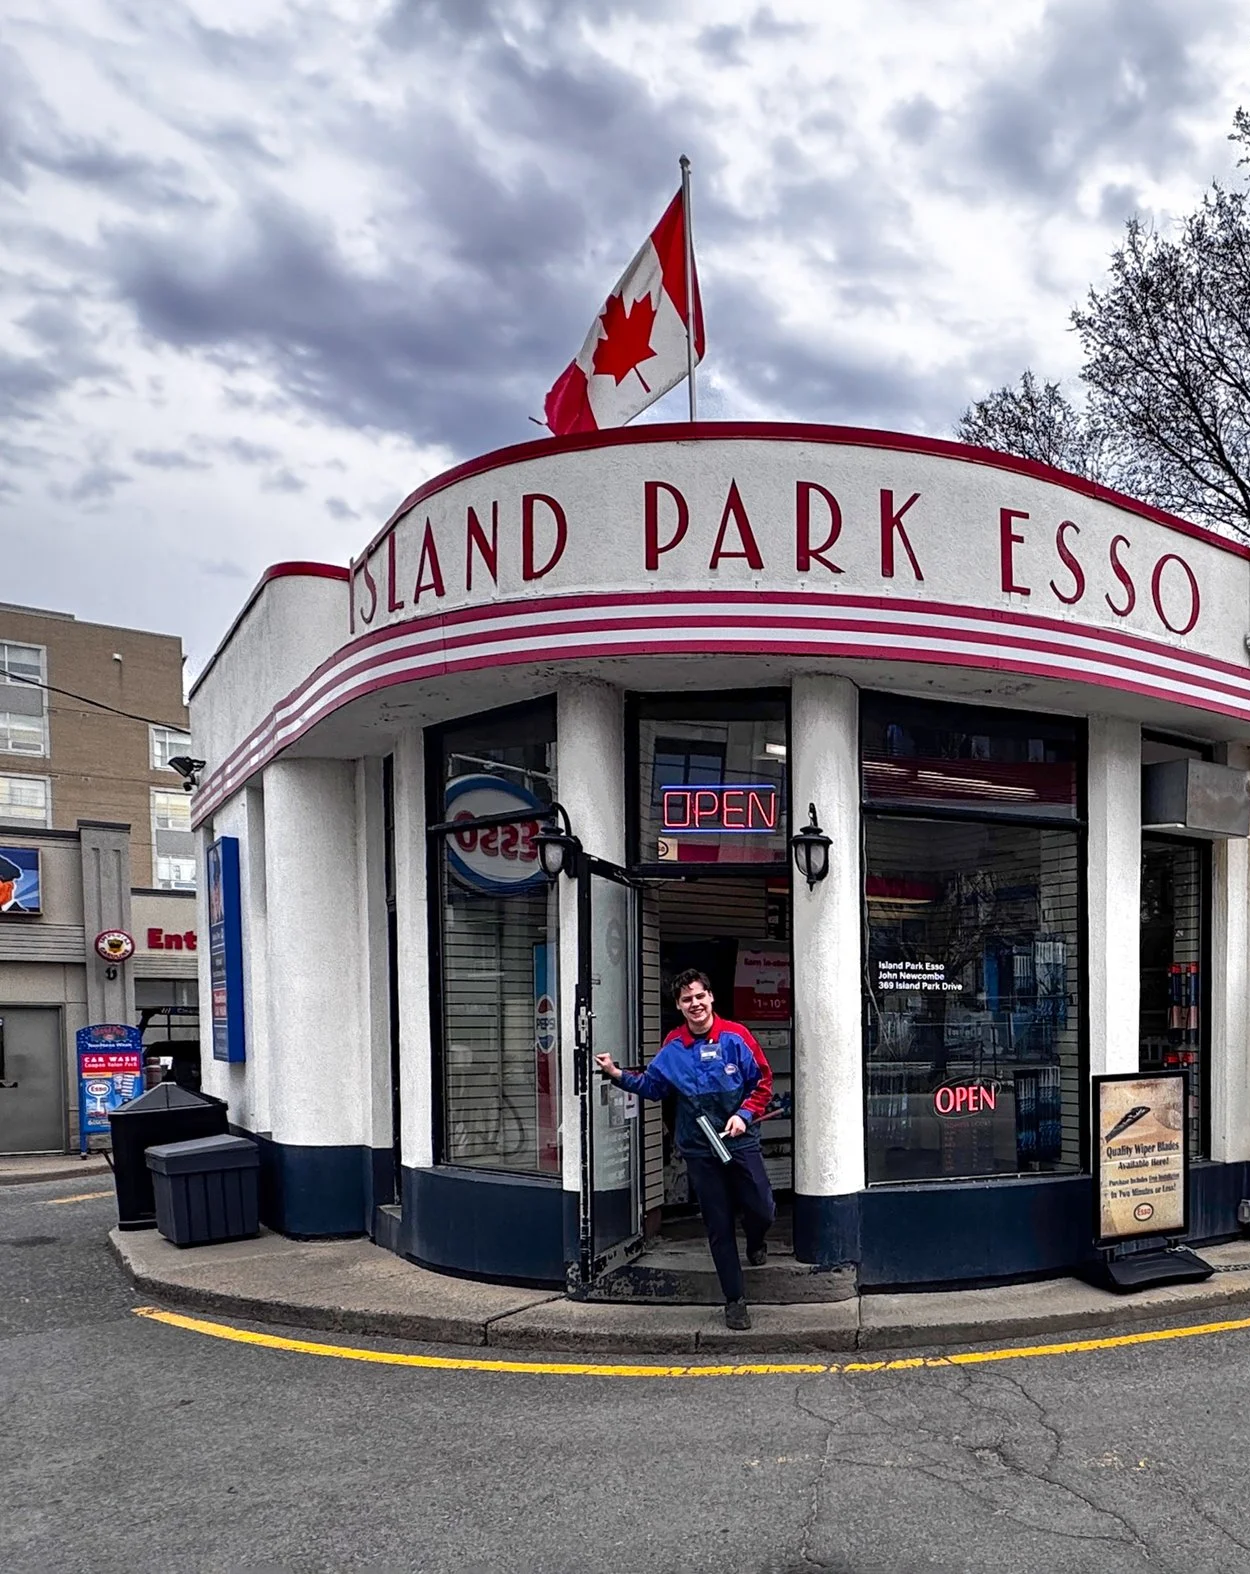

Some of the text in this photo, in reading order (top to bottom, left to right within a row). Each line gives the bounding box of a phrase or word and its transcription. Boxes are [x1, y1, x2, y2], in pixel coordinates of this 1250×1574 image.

[349, 477, 1202, 635] ISLAND PARK ESSO
[664, 791, 776, 828] OPEN
[878, 961, 945, 971] Island Park Esso
[878, 971, 945, 980] John Newcombe
[878, 981, 963, 991] 369 Island Park Drive
[935, 1084, 995, 1114] OPEN
[1106, 1140, 1179, 1159] Quality Wiper Blades
[1118, 1157, 1169, 1170] Available Here!
[1136, 1207, 1151, 1216] Esso
